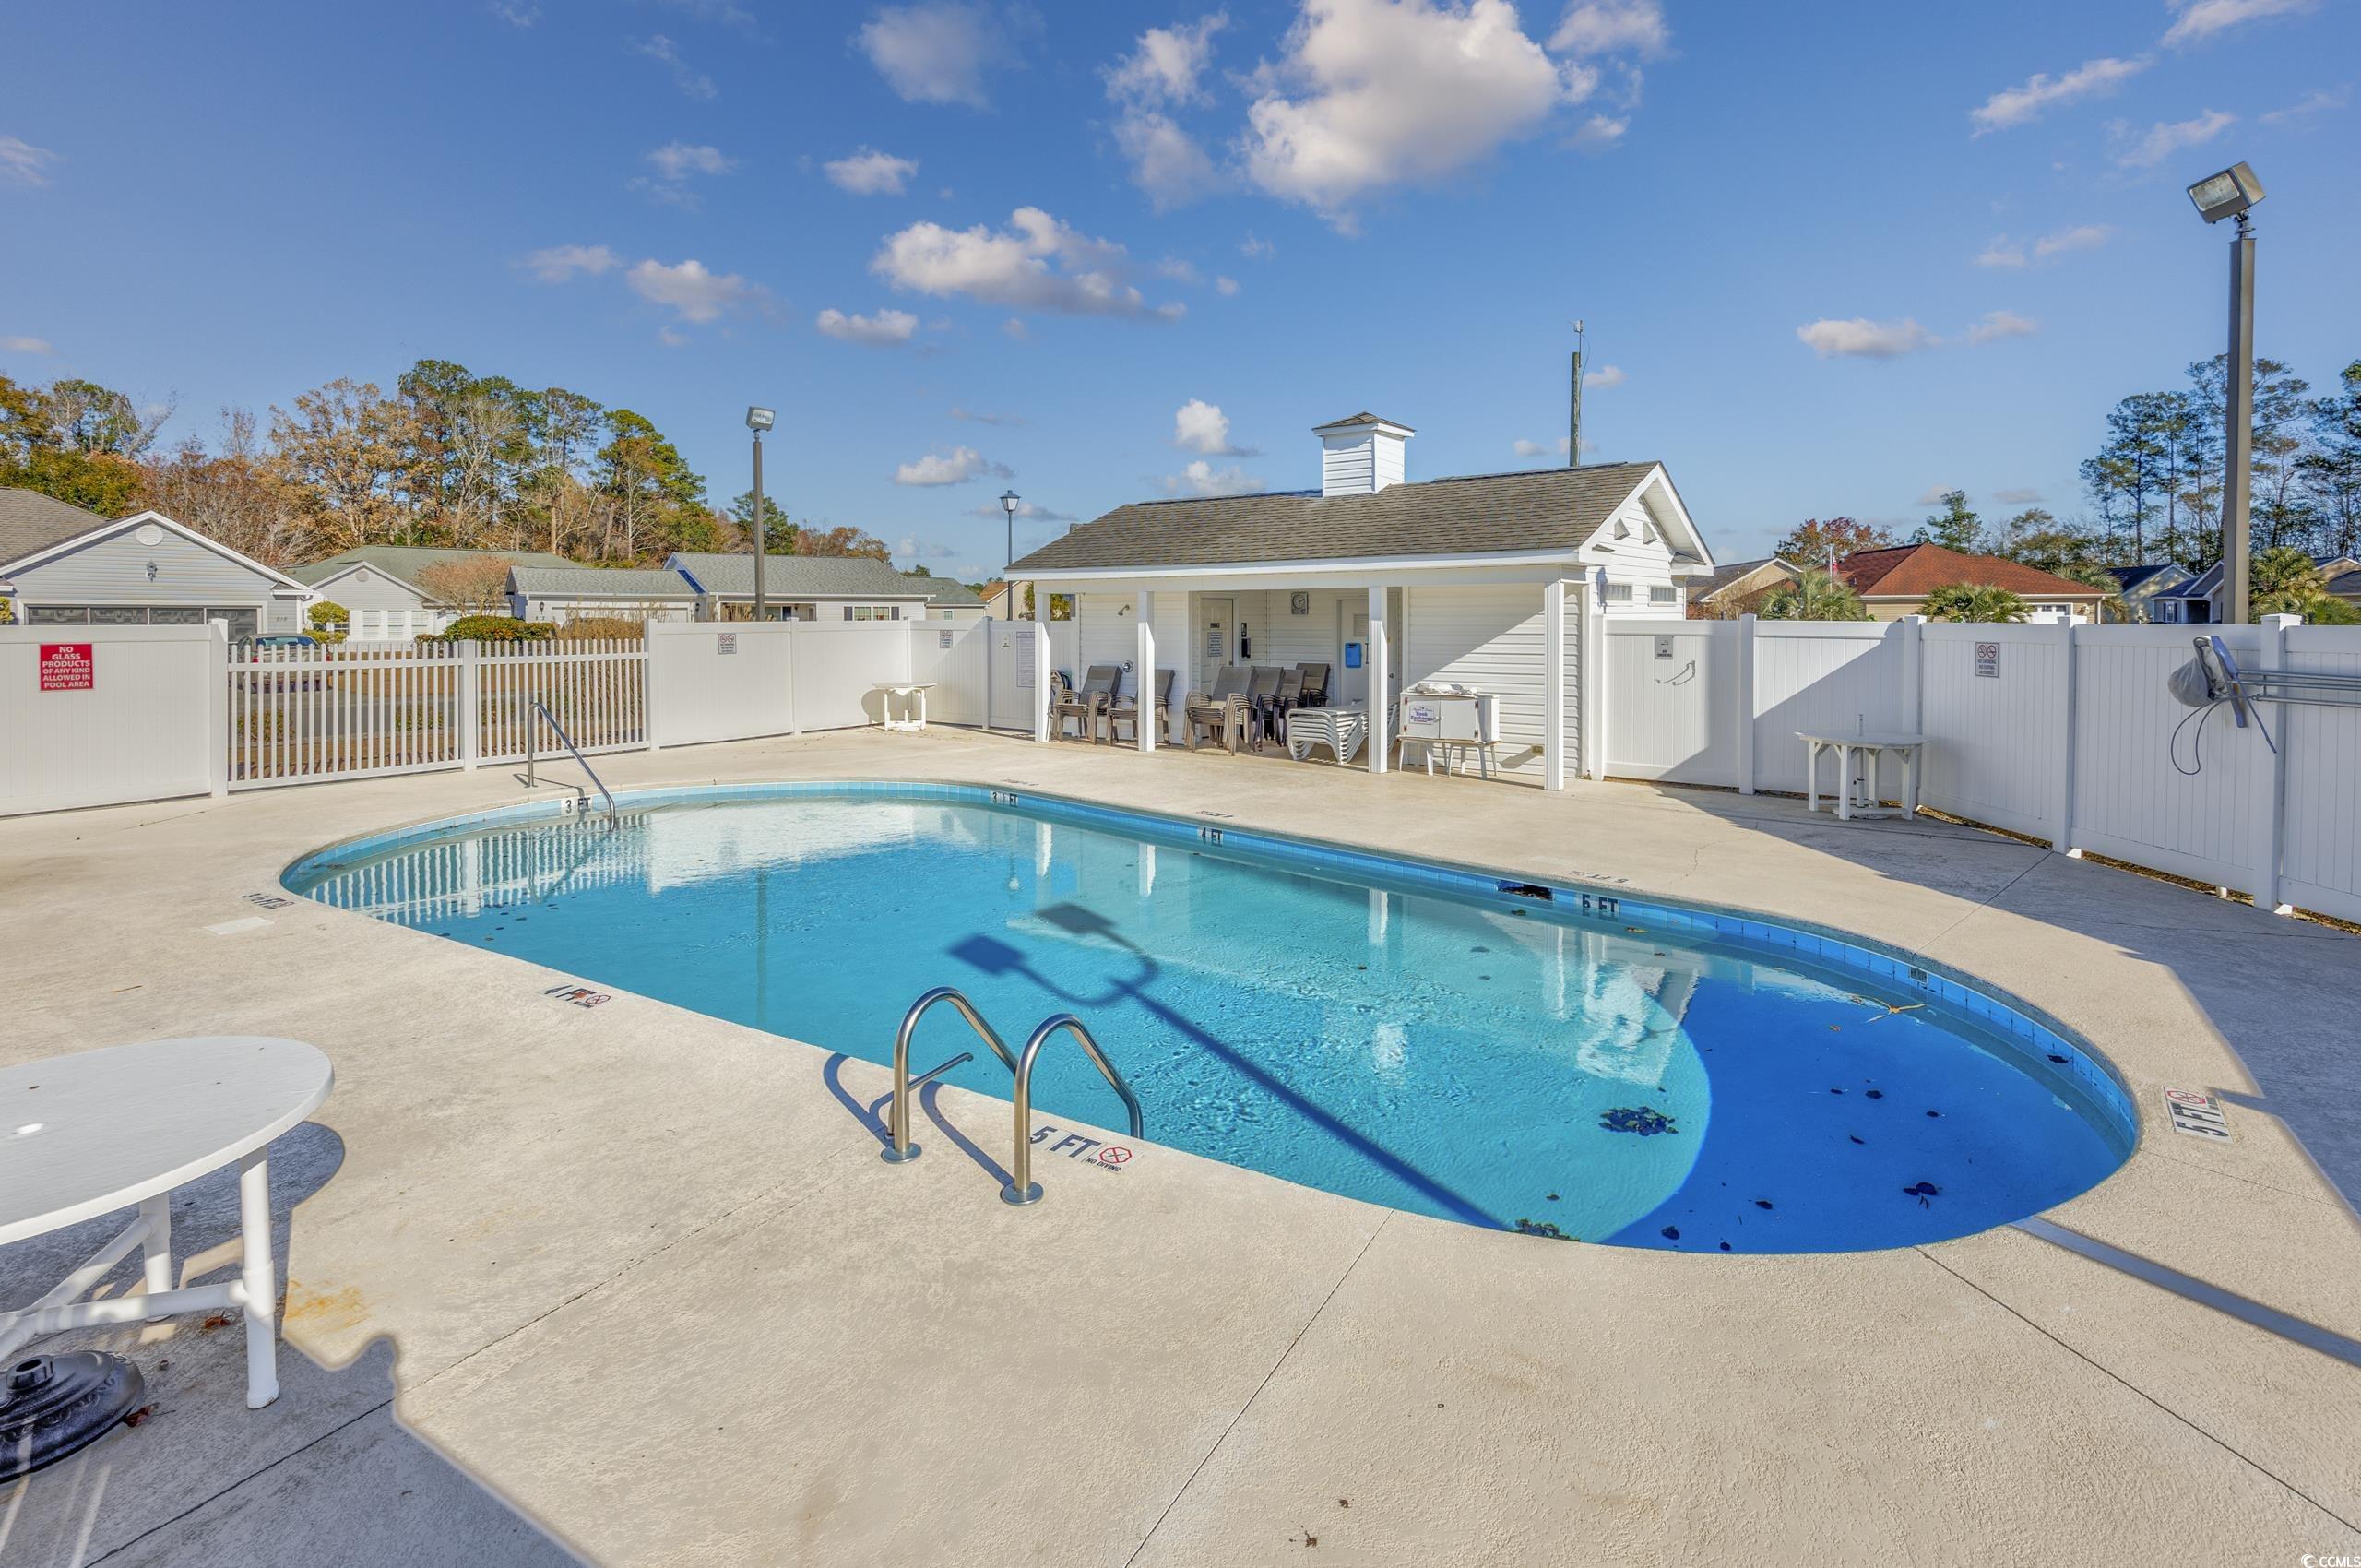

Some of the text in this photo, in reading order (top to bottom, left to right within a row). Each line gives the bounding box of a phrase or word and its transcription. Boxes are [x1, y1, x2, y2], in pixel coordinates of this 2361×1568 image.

[565, 799, 572, 812] 3
[1598, 896, 1619, 913] FT
[543, 984, 573, 995] 4
[2170, 1102, 2229, 1137] 5 FT
[1029, 1125, 1102, 1158] 5 FT
[1097, 1160, 1122, 1172] DIVING
